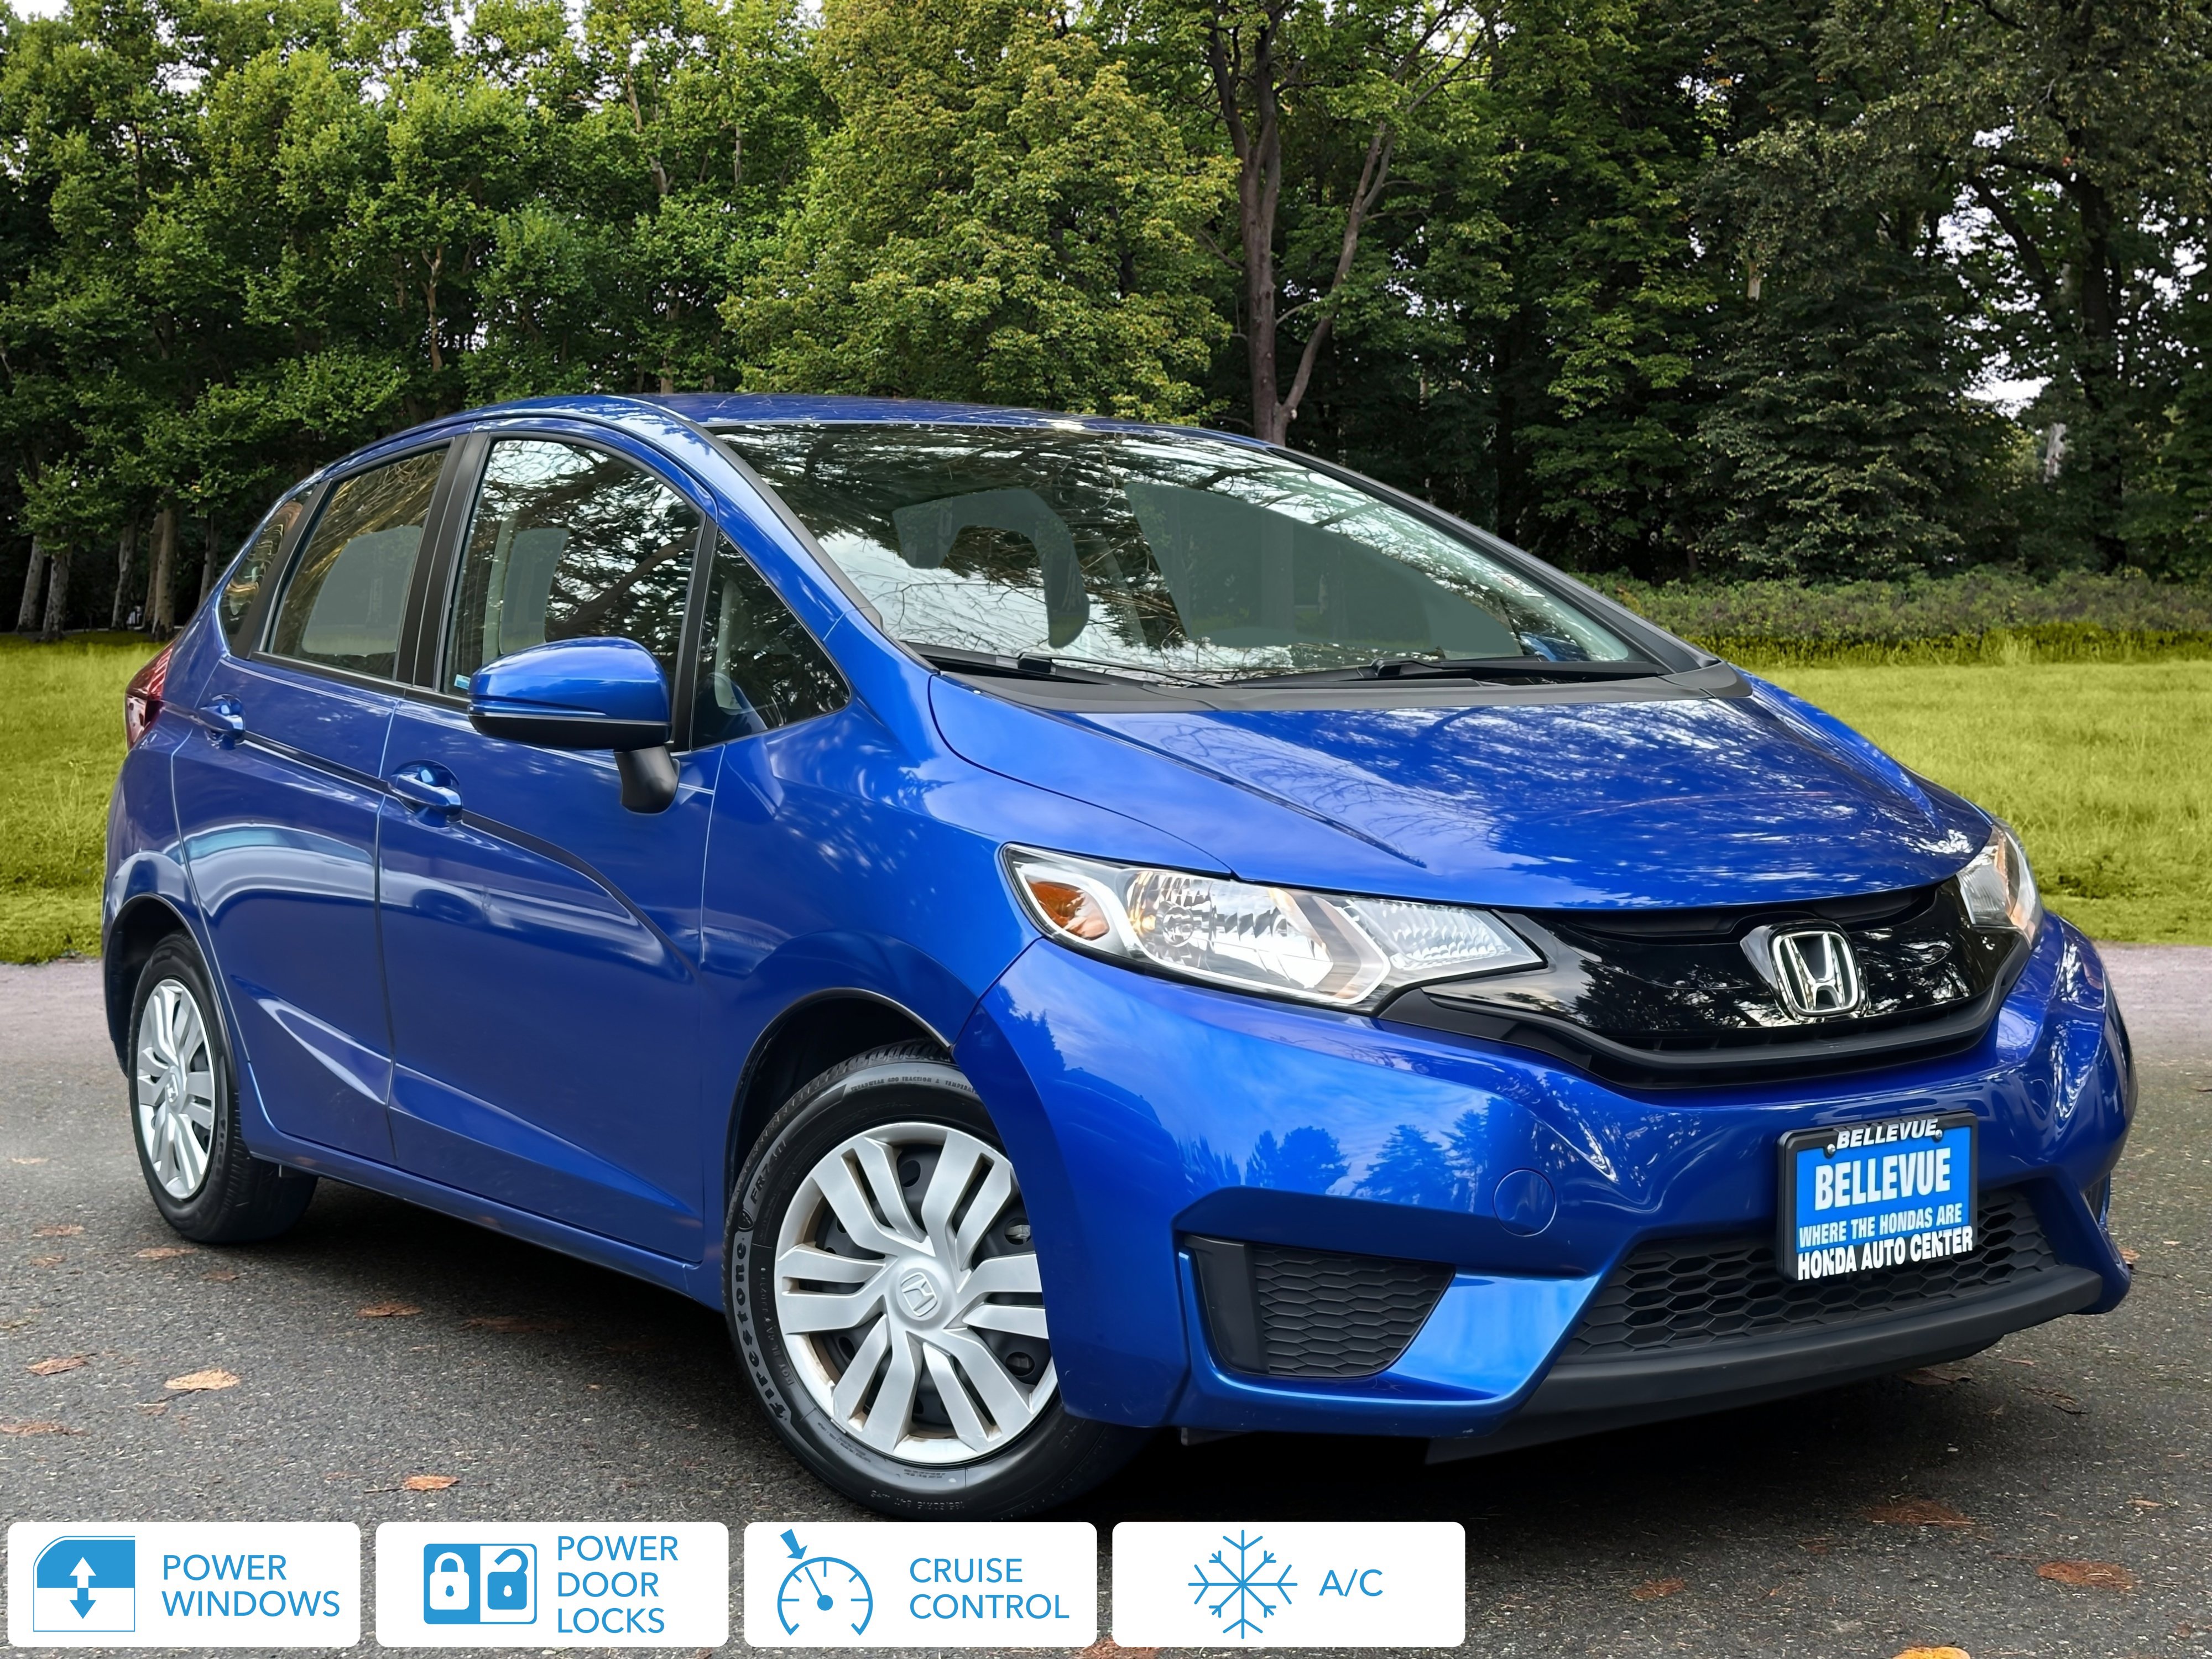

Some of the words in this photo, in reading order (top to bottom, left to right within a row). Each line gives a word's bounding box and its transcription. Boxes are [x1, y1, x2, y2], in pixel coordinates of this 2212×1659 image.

[1837, 1118, 1938, 1150] BELLEVUE
[1815, 1147, 1951, 1211] BELLEVUE
[1798, 1245, 1858, 1281] HONDA
[1860, 1237, 1906, 1270] AUTO
[1910, 1225, 1973, 1262] CENTER
[1799, 1220, 1847, 1248] WHERE
[1851, 1216, 1876, 1240] THE
[1879, 1207, 1933, 1235] HONDAS
[1936, 1202, 1963, 1227] ARE
[735, 1242, 786, 1419] Firestone
